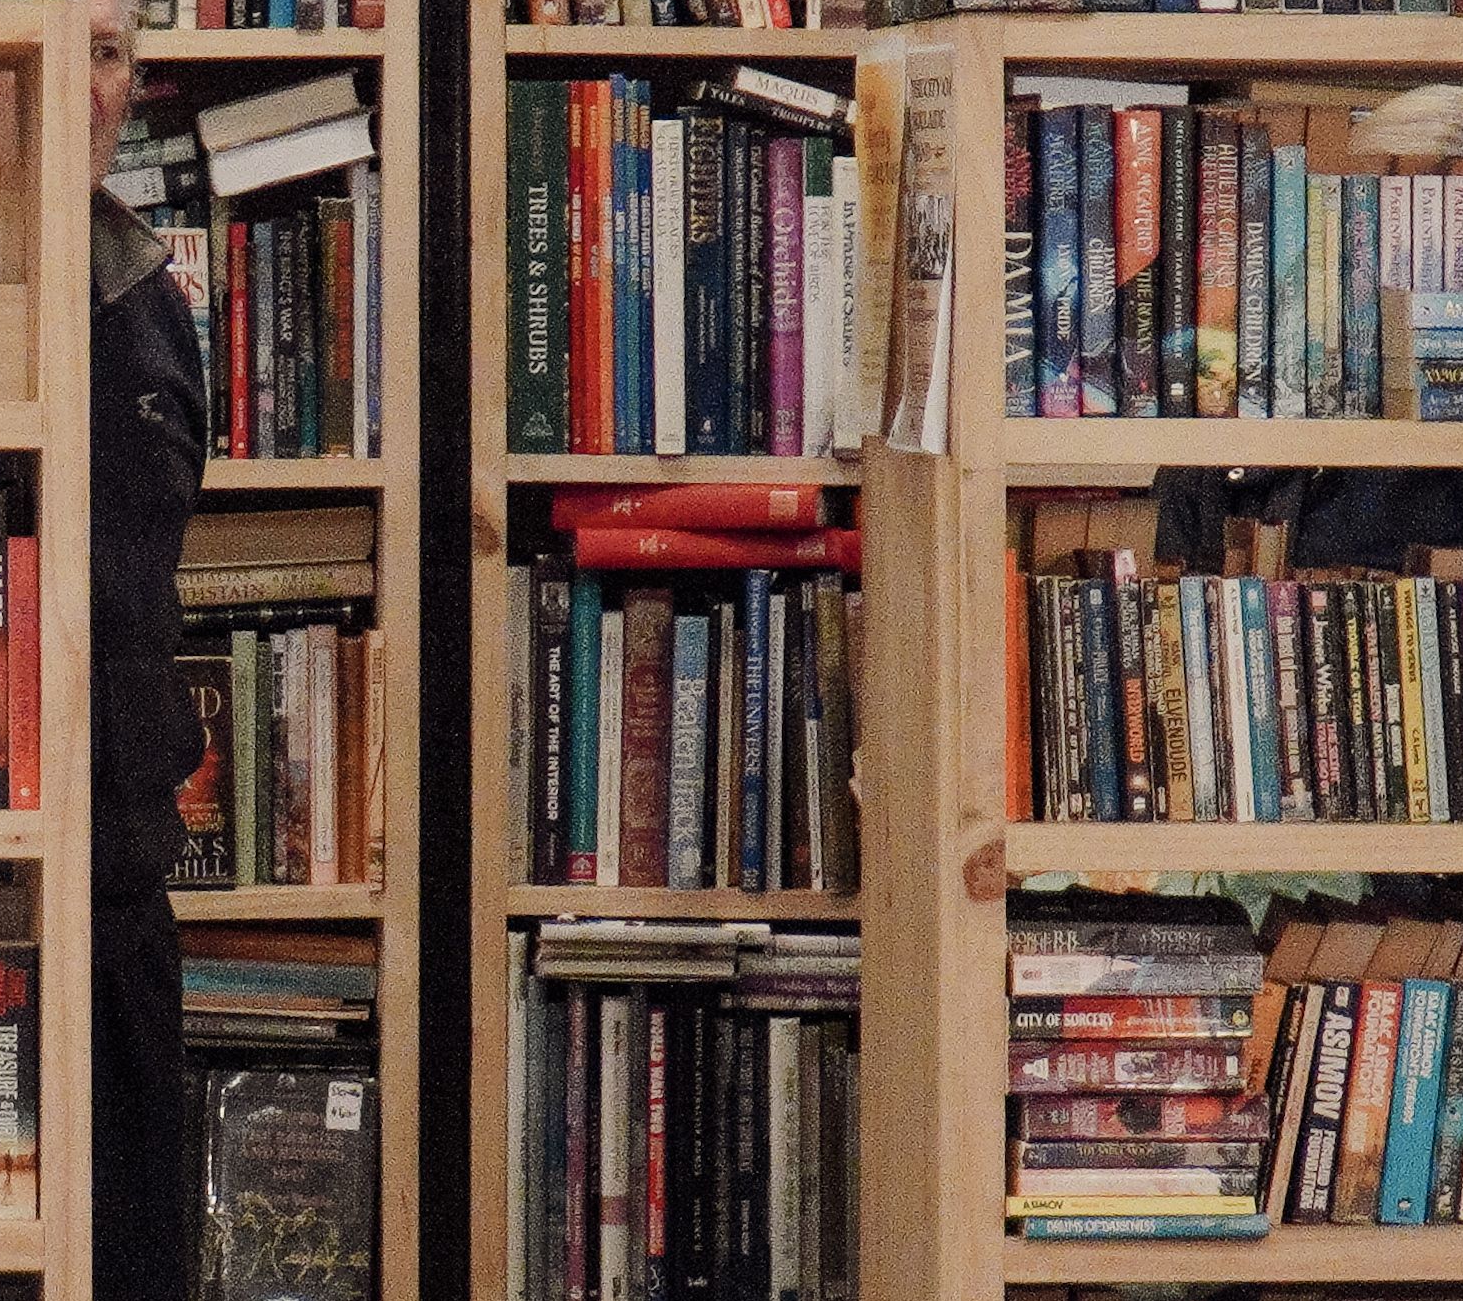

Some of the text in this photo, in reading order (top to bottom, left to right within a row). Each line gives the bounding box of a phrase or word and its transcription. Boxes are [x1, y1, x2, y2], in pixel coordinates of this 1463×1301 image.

[527, 183, 549, 375] TREES & SHRUBS
[771, 207, 797, 316] Orchids
[547, 646, 561, 821] THE ART OF THE INTERIOR
[1162, 688, 1188, 783] ELVENDUDE
